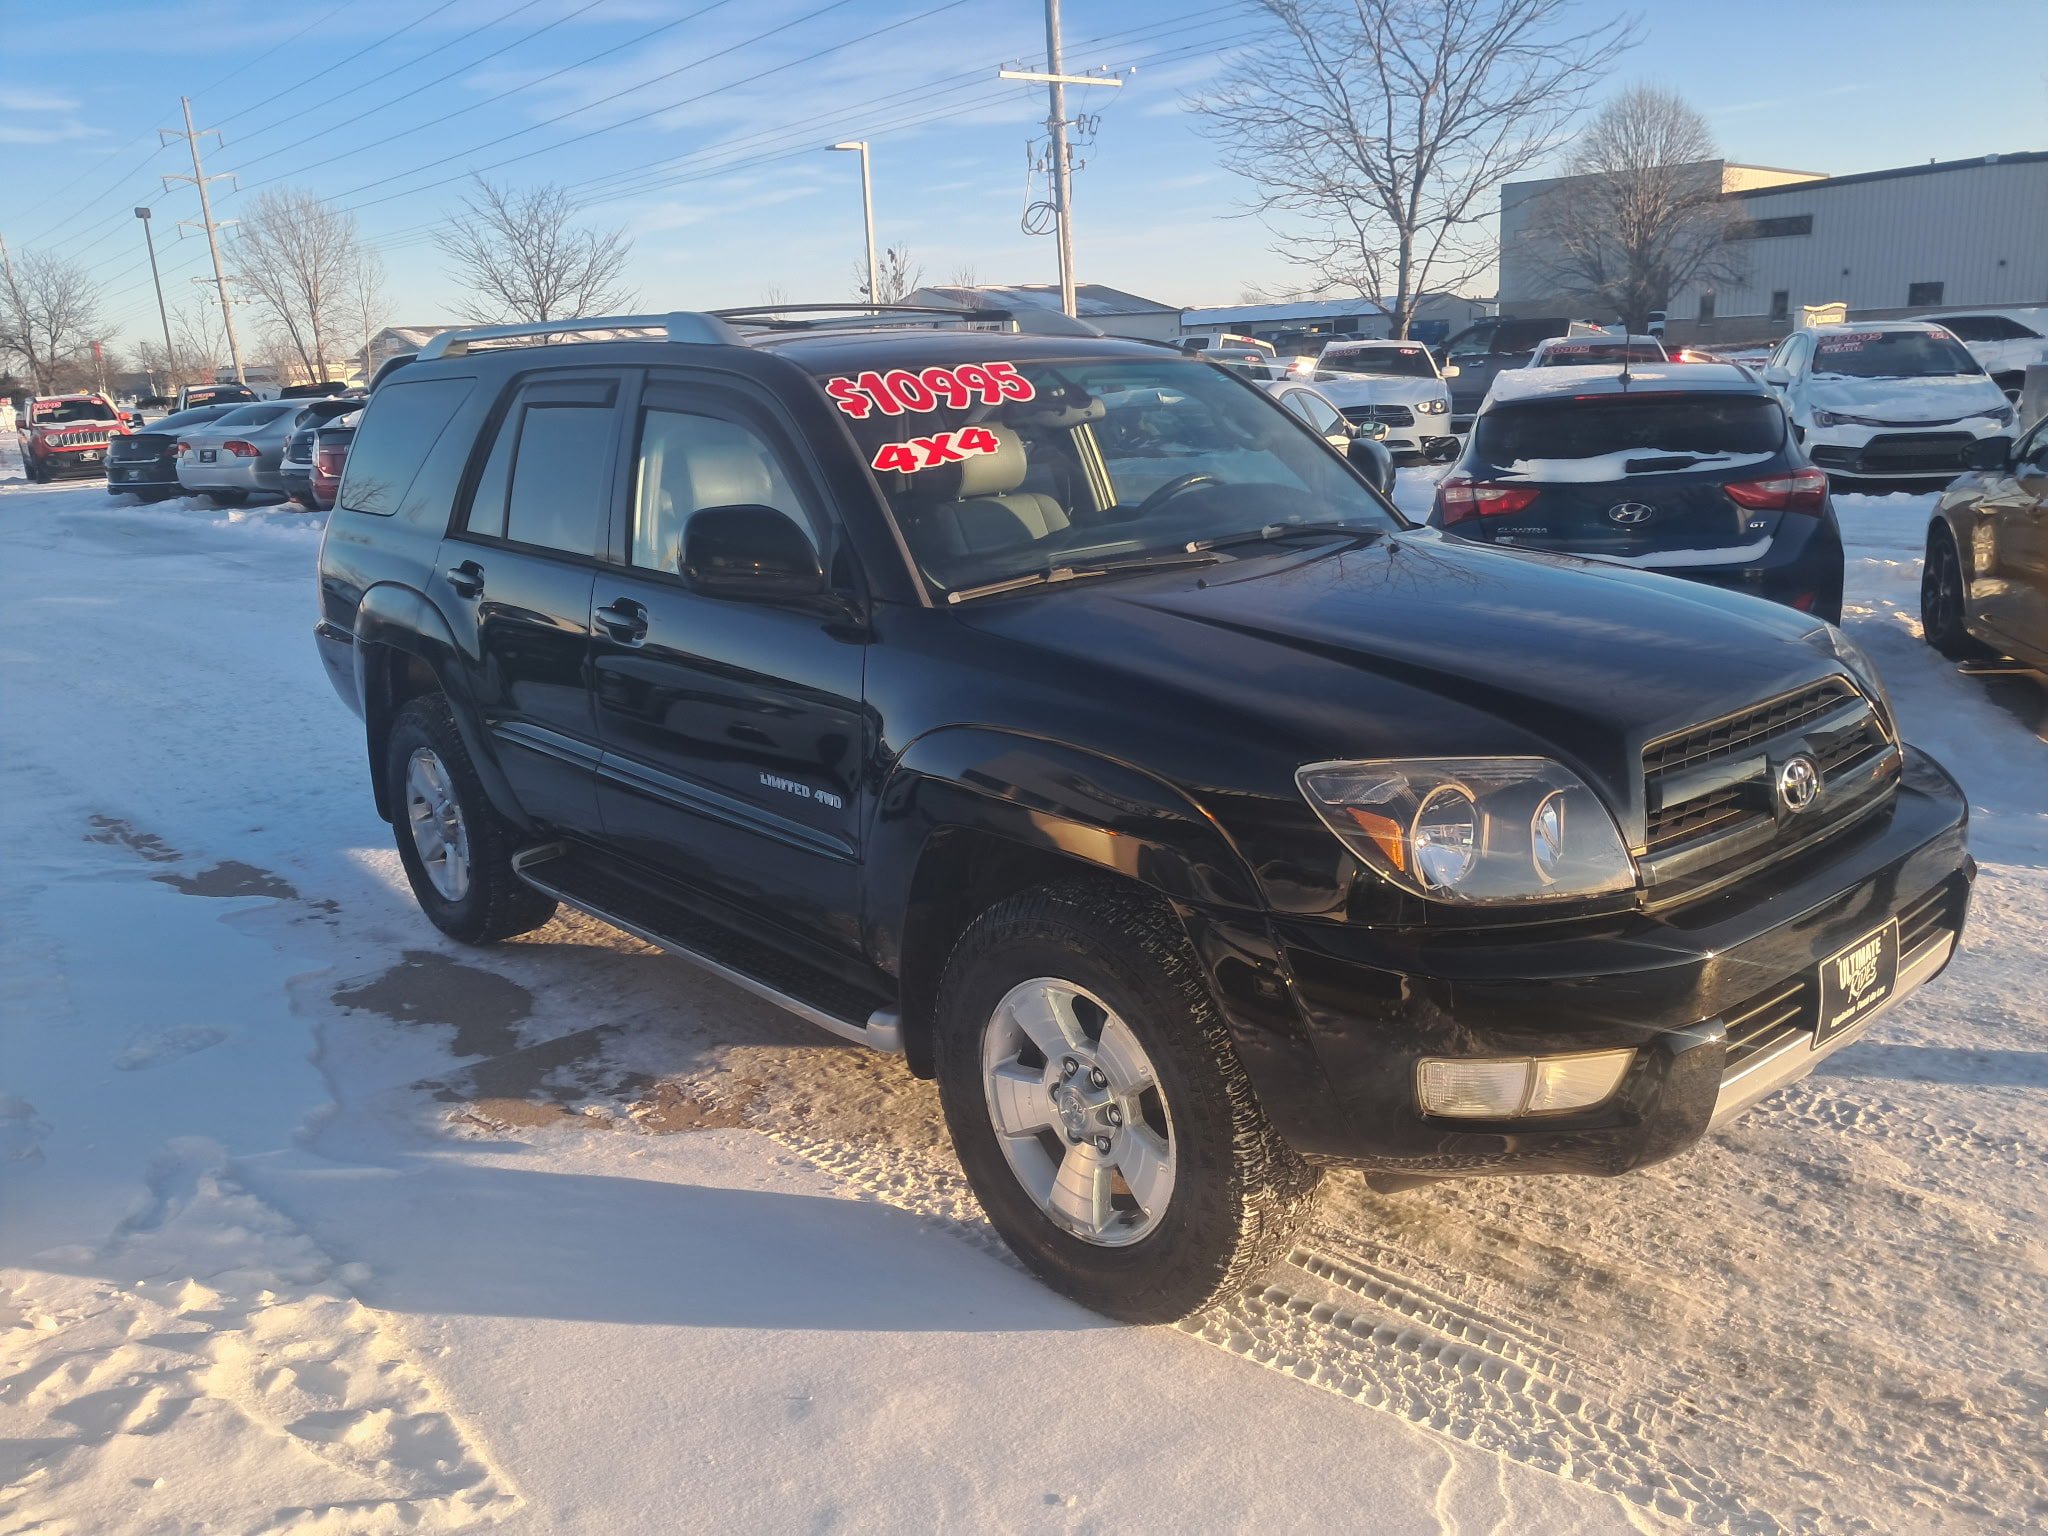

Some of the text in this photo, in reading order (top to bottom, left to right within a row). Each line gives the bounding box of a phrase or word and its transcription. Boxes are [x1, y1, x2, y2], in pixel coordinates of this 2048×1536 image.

[824, 361, 1036, 419] $10995
[871, 426, 1000, 473] 4X4
[1749, 520, 1767, 528] GT
[759, 771, 842, 809] LIMITED 4WD
[1838, 936, 1882, 991] ULTIMATE
[1847, 956, 1878, 1003] RIDES
